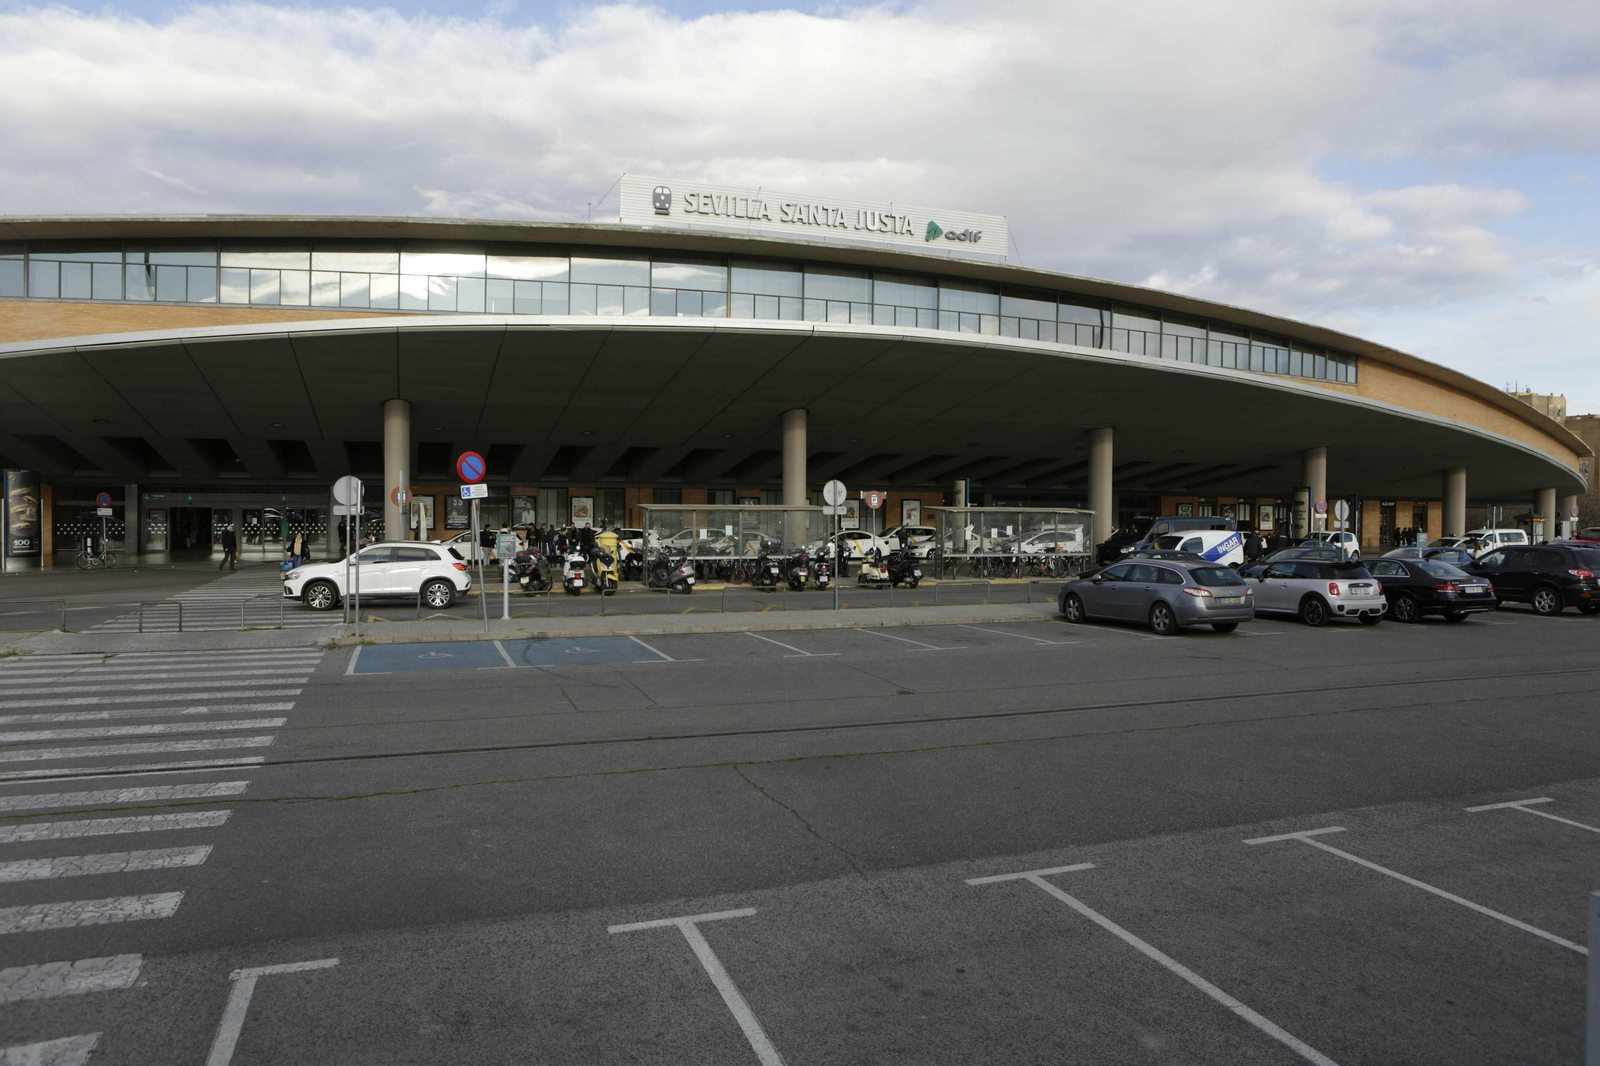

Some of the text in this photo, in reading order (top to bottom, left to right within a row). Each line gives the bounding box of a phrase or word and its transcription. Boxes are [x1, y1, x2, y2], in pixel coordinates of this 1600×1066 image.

[684, 192, 914, 235] SEVILLA SANTA JUSTA
[945, 228, 982, 243] adif
